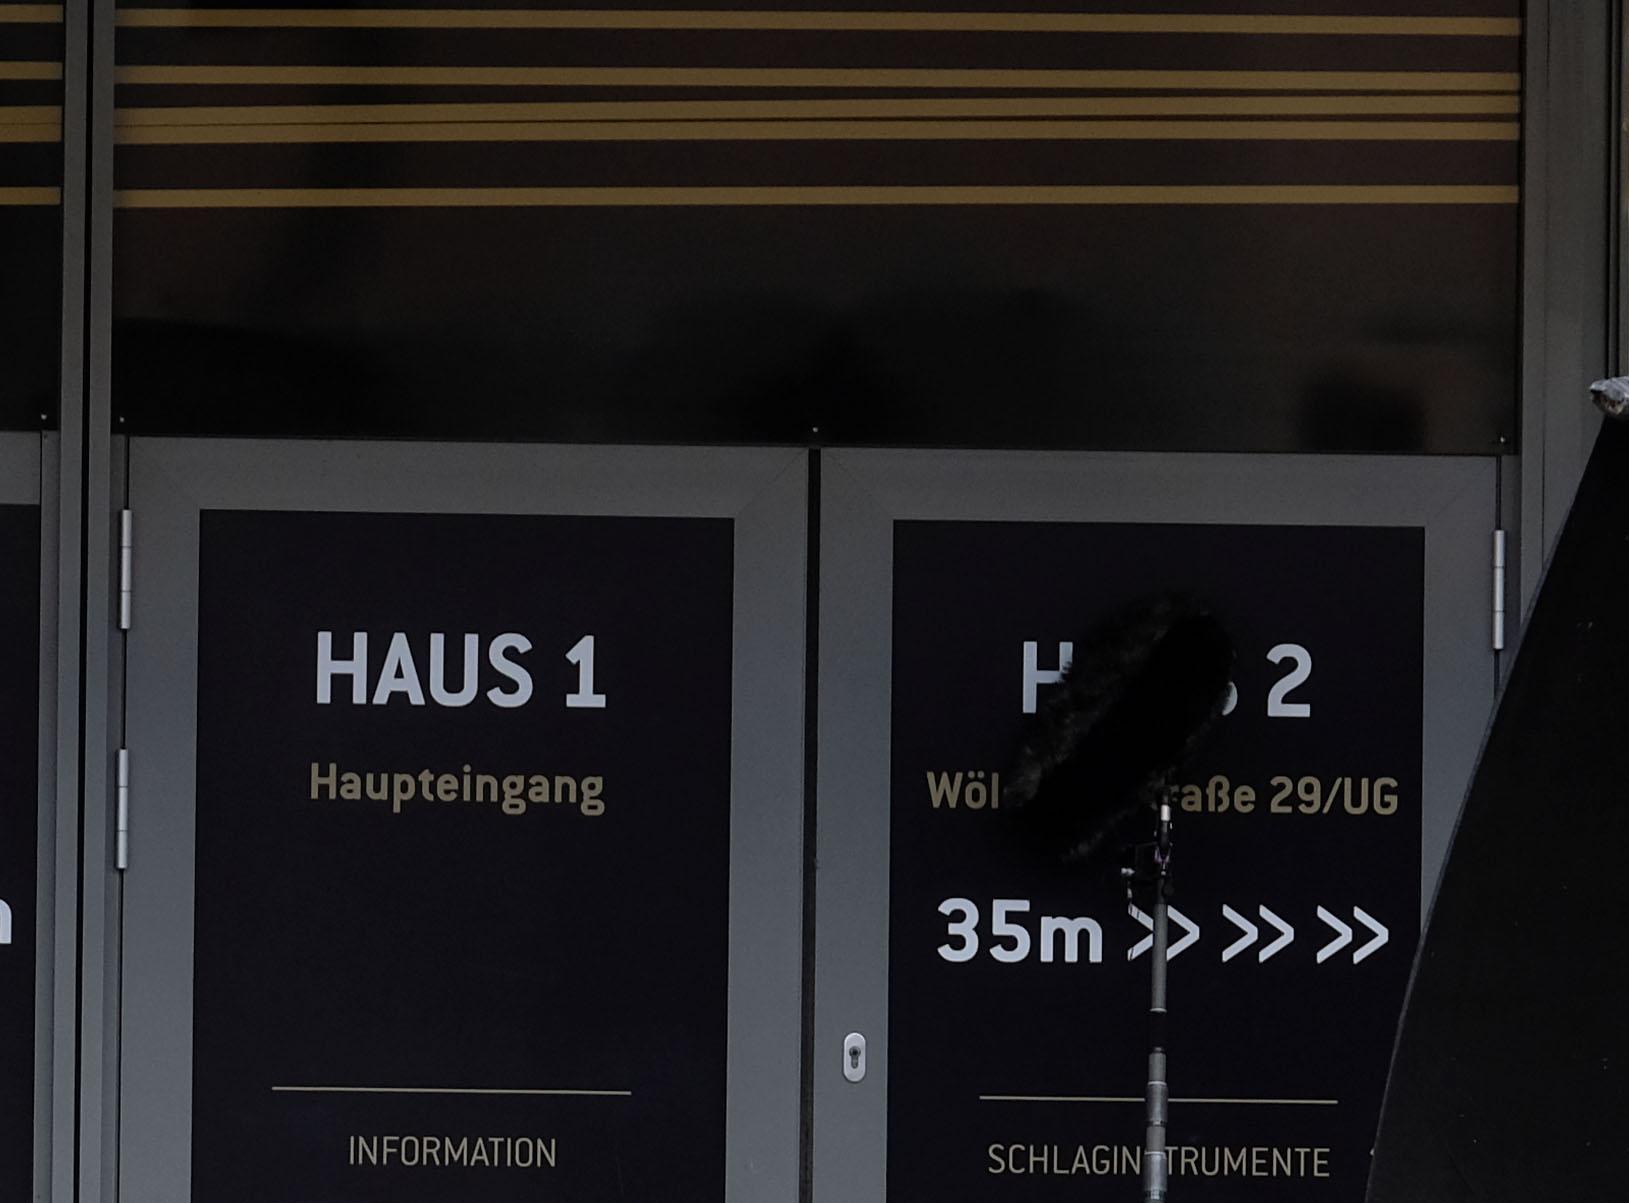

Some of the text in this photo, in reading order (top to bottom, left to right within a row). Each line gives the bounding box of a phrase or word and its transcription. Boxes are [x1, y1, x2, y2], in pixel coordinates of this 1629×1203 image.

[316, 630, 607, 709] HAUS 1
[1265, 643, 1312, 718] 2
[310, 762, 606, 816] Haupteingang
[1269, 774, 1399, 816] 29/UG
[937, 897, 1103, 964] 35m
[348, 1135, 557, 1169] INFORMATION
[987, 1143, 1331, 1178] SCHLAGINTRUMENTE
